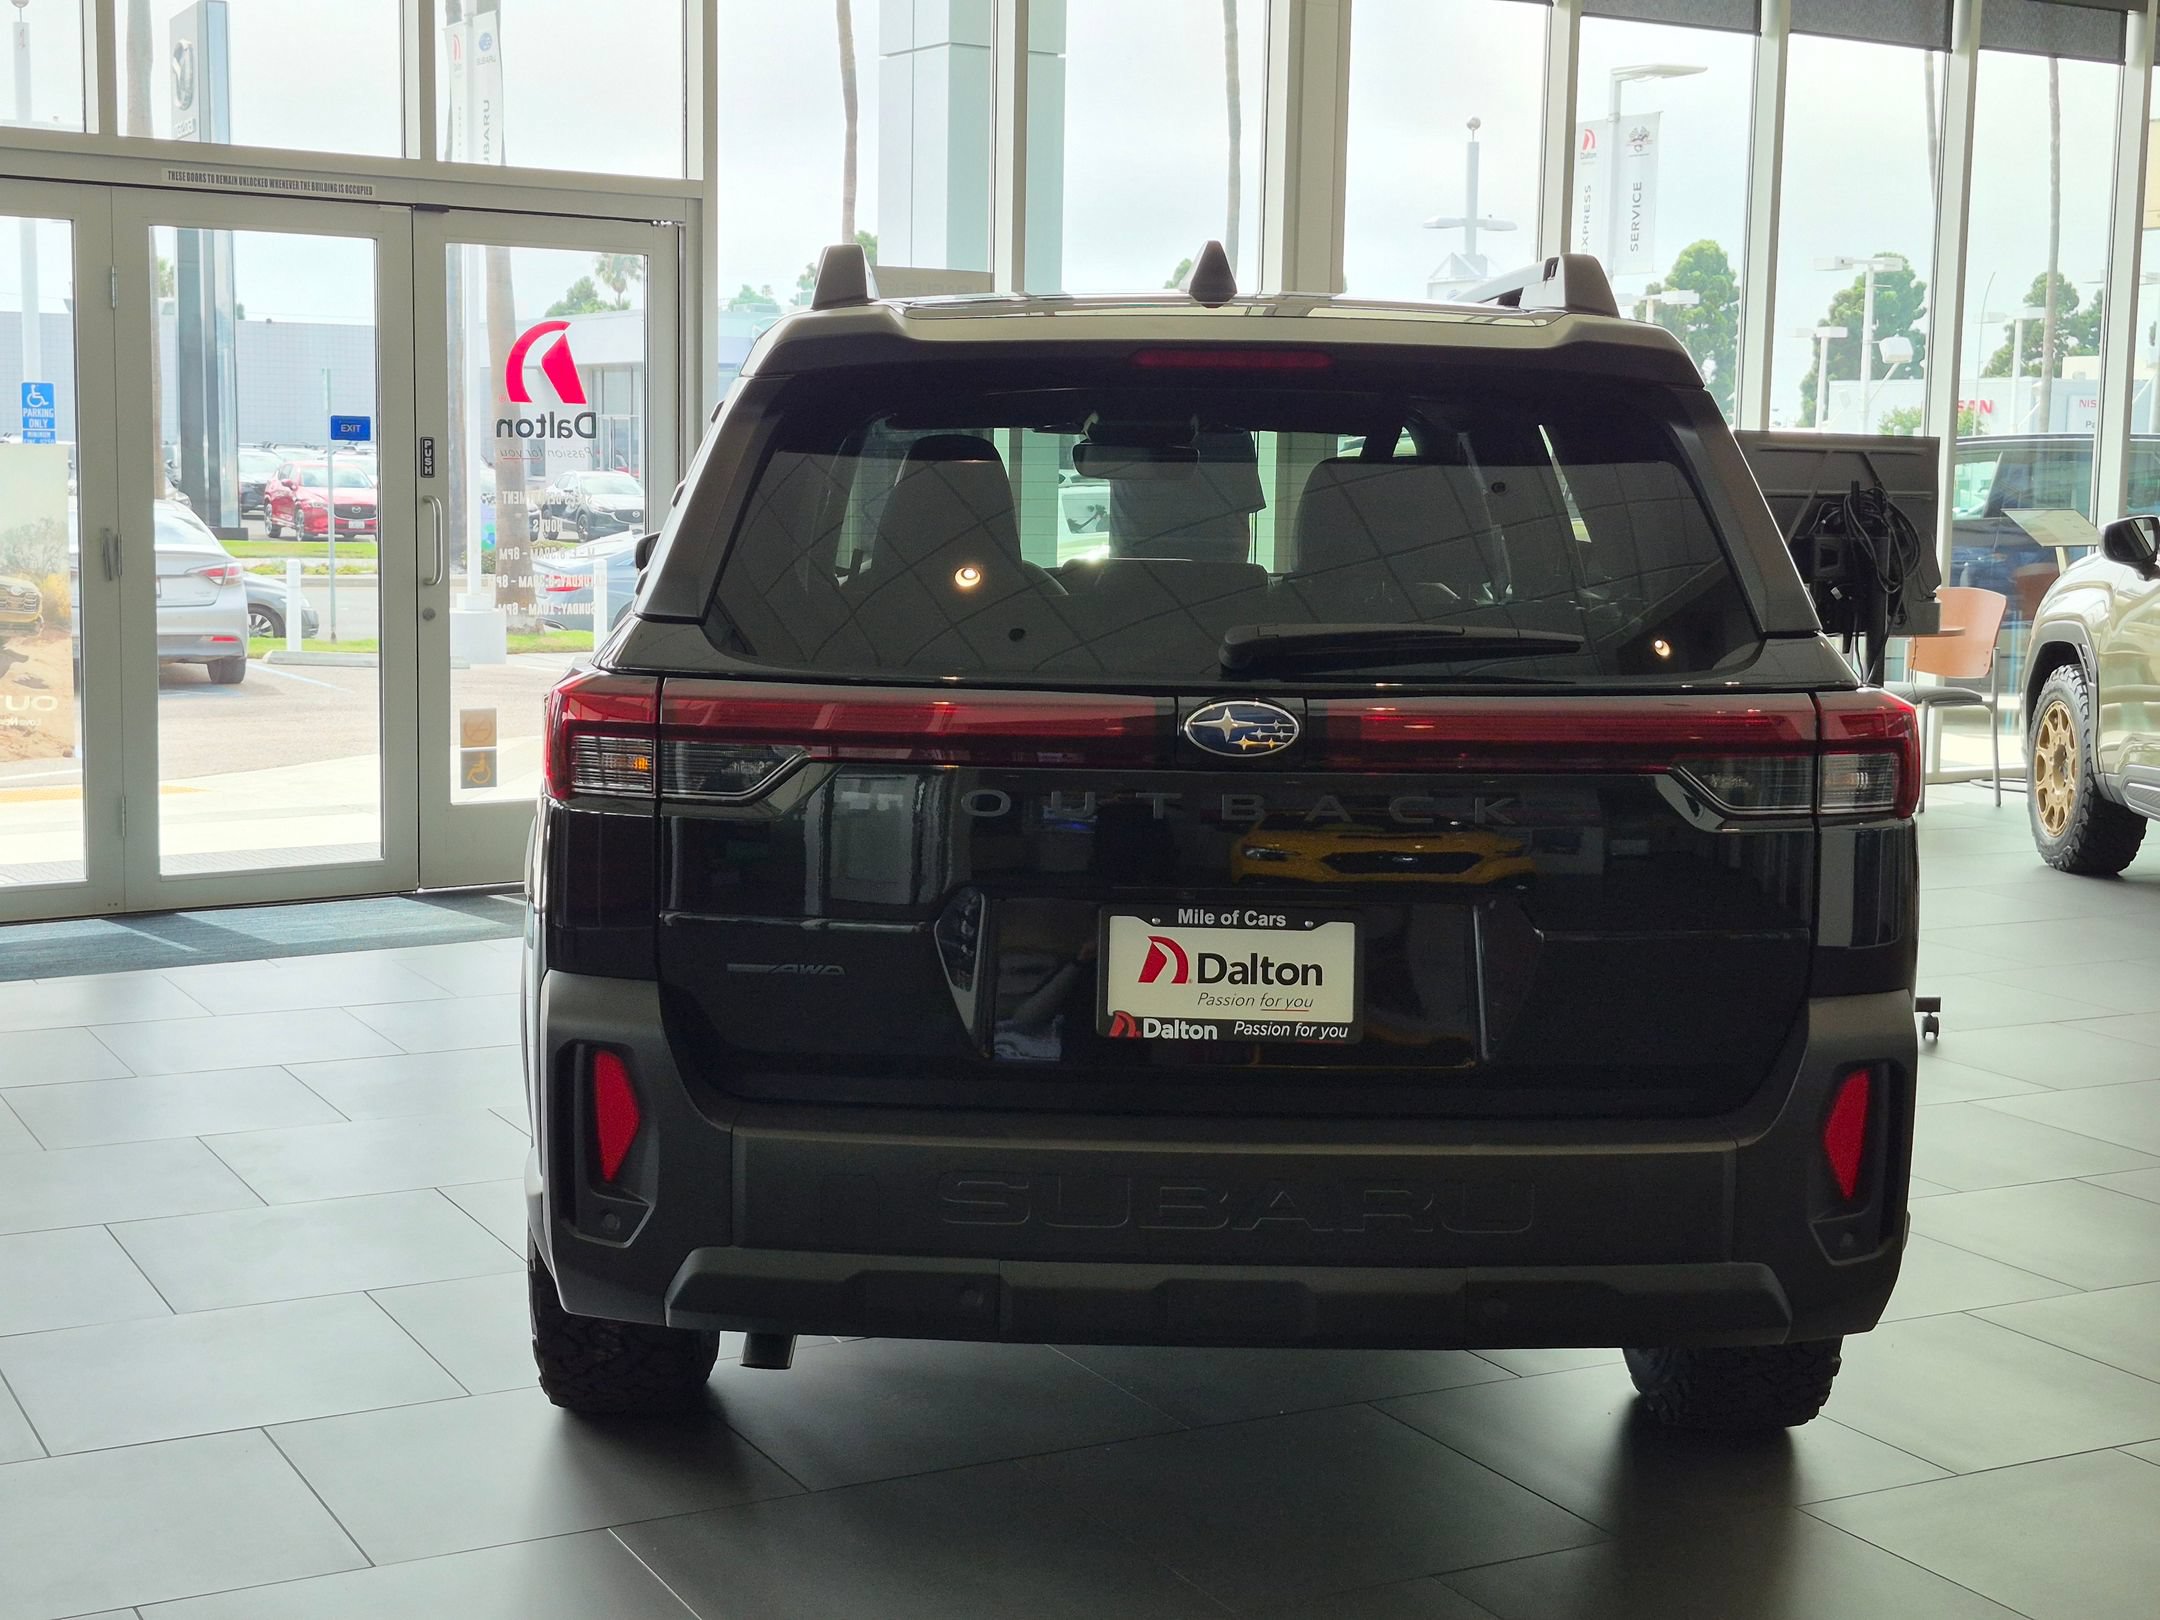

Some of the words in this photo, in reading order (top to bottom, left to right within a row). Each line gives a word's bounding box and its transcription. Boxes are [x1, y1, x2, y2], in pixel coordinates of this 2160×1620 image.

[168, 170, 186, 182] THESE
[186, 172, 207, 184] DOORS
[207, 173, 215, 184] TO
[216, 174, 238, 186] REMAIN
[238, 176, 268, 188] UNLOCKED
[269, 178, 300, 190] WHENEVER
[300, 181, 311, 191] THE
[311, 182, 338, 193] BUILDING
[338, 184, 344, 194] IS
[345, 184, 373, 196] OCCUPIED
[1630, 181, 1642, 252] SERVICE
[23, 407, 54, 418] PARKING
[29, 418, 49, 428] ONLY
[340, 424, 361, 433] EXIT
[424, 440, 433, 475] PUSH
[959, 788, 1518, 825] OUTBACK
[1177, 908, 1215, 925] Mile
[1220, 909, 1240, 925] of
[1244, 910, 1287, 927] Cars
[1197, 952, 1323, 986] Dalton
[1197, 992, 1255, 1008] Passion
[1259, 993, 1282, 1008] for
[1284, 996, 1314, 1010] you
[1143, 1018, 1218, 1040] Dalton
[1234, 1021, 1290, 1037] Passion
[1294, 1022, 1316, 1038] for
[1320, 1026, 1349, 1040] you
[937, 1168, 1535, 1234] SUBARU
